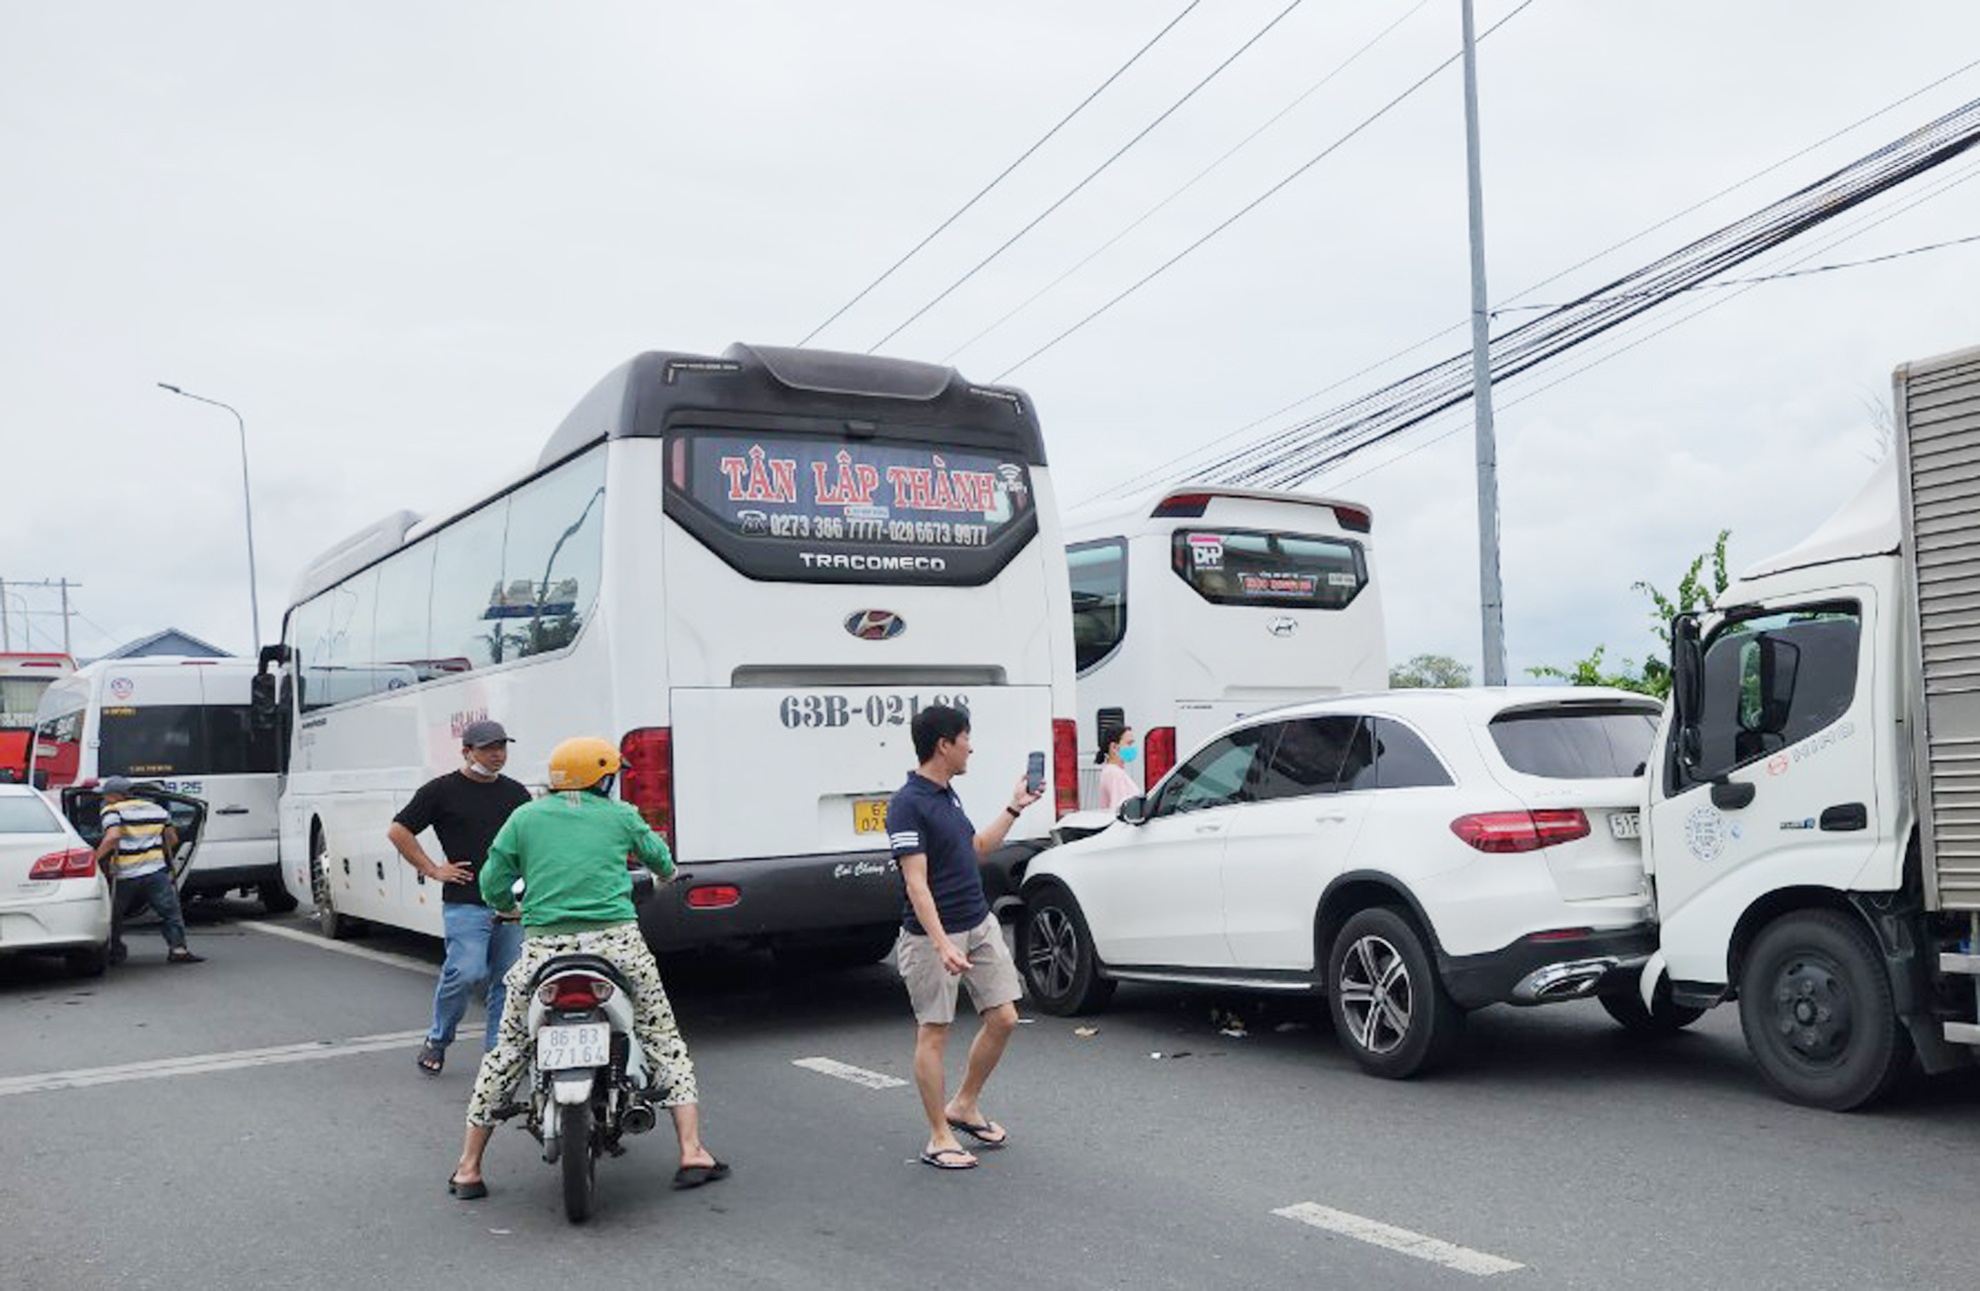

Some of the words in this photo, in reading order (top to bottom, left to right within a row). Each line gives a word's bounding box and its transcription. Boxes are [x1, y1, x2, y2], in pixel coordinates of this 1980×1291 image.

[721, 444, 796, 503] TÂN
[887, 455, 996, 512] THÀNH
[770, 513, 810, 537] 0273
[954, 523, 988, 546] 9977
[799, 552, 946, 571] TRACOMECO
